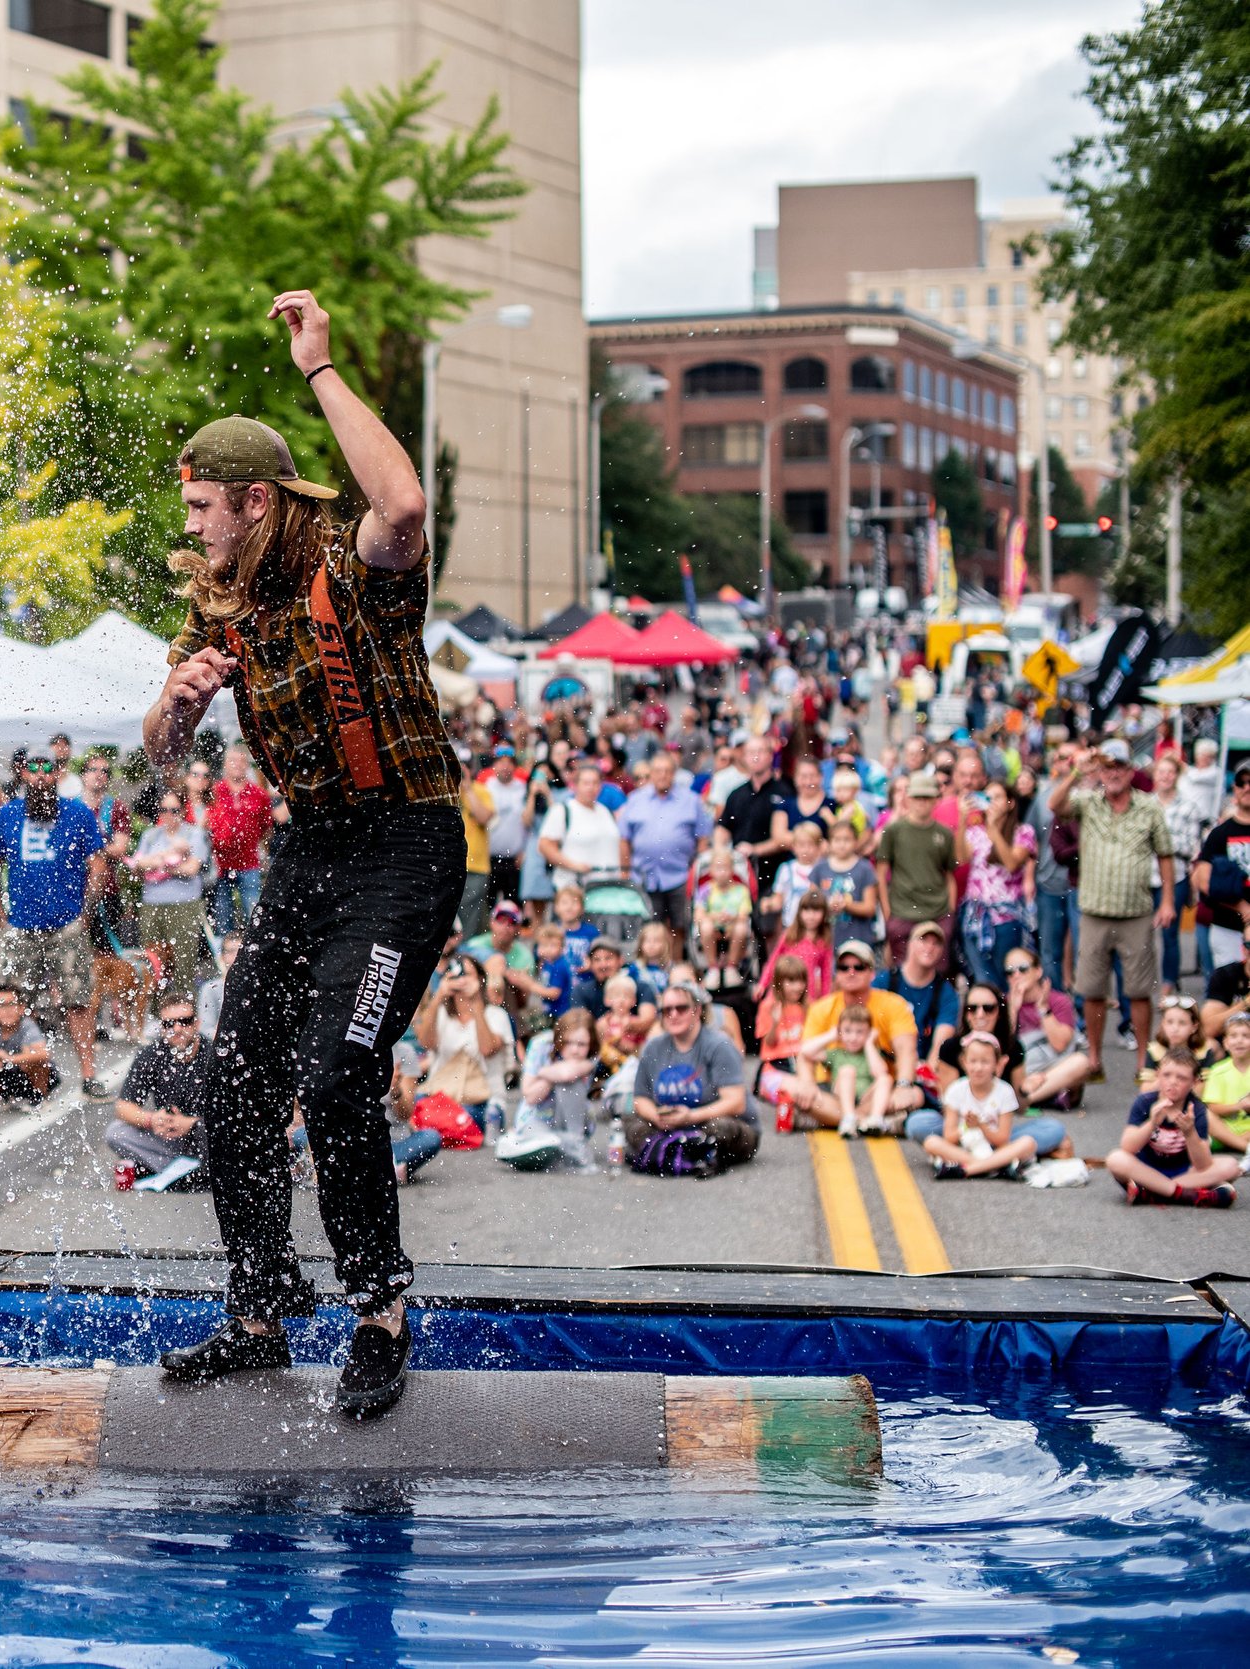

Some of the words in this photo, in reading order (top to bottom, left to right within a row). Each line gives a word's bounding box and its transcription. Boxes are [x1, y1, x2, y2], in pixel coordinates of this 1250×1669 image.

[345, 943, 402, 1049] DULUTH
[352, 963, 379, 1022] TRADING
[357, 984, 365, 995] CO
